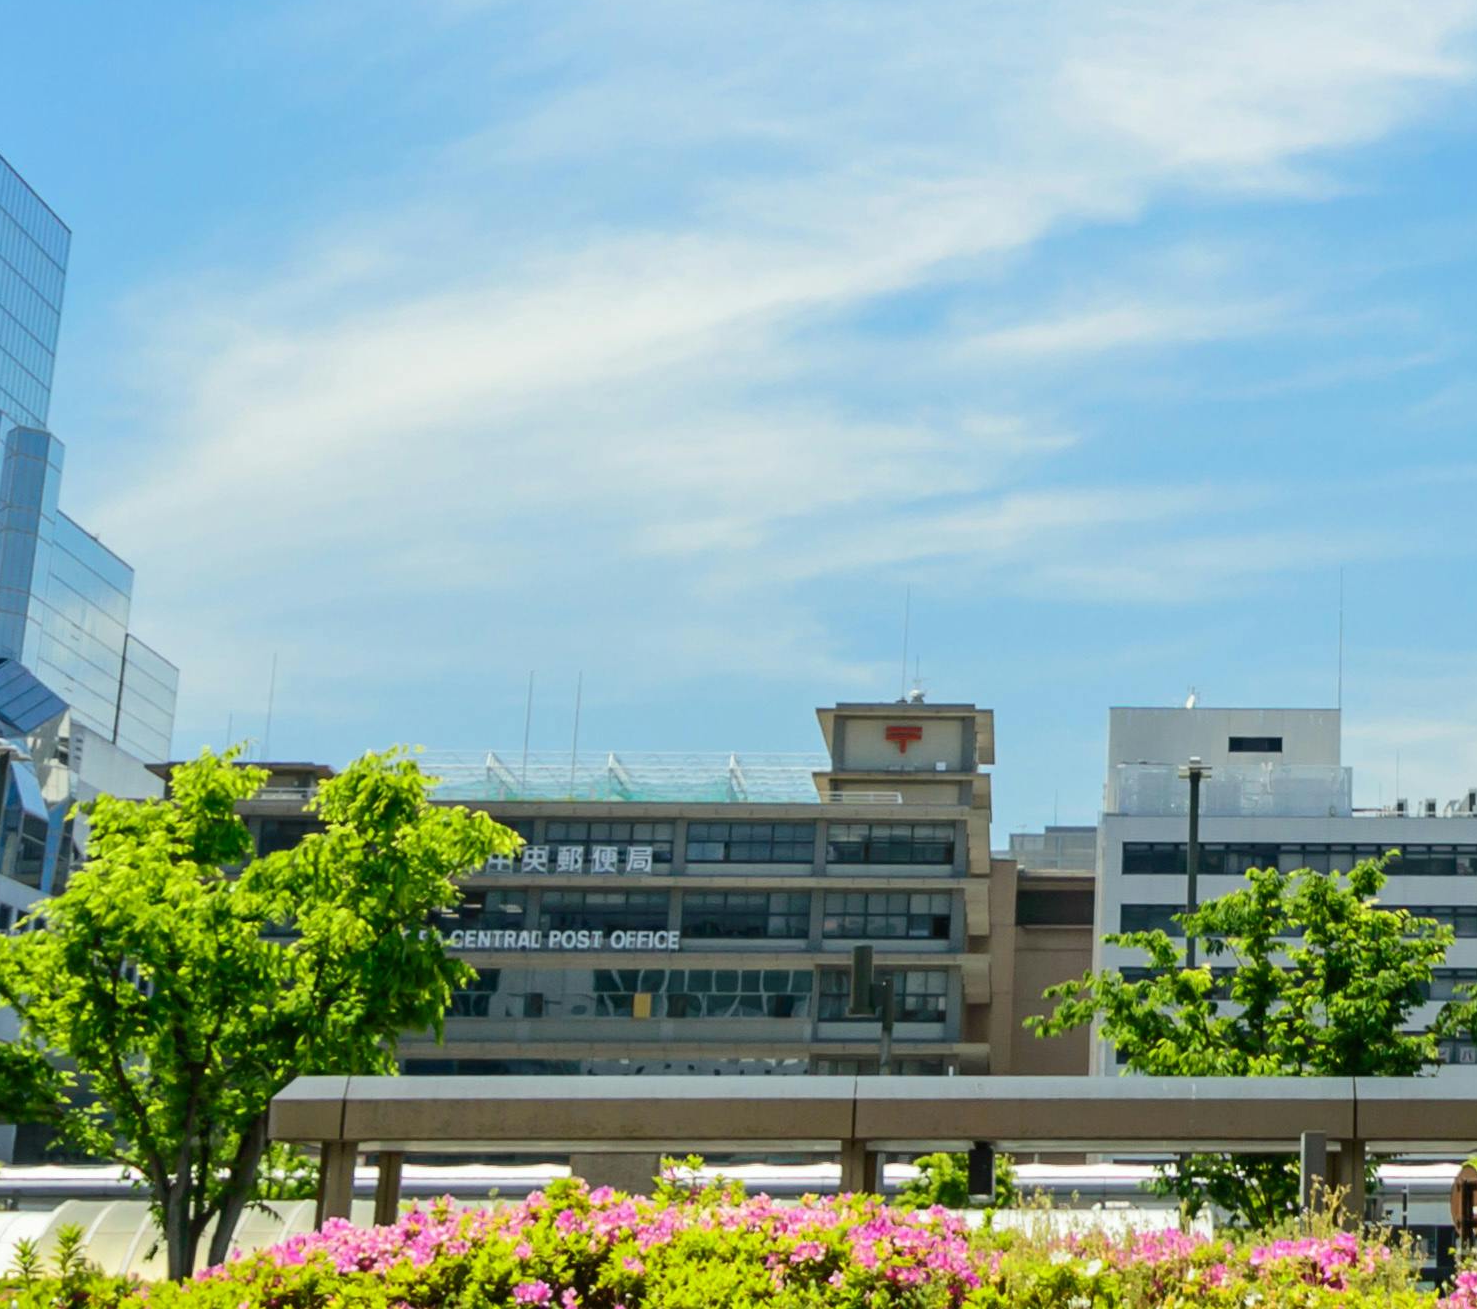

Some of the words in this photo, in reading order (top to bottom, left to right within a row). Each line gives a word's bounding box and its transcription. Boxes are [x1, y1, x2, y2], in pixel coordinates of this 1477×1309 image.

[449, 930, 541, 950] CENTRAL
[548, 930, 603, 949] POST
[610, 930, 680, 950] OFFICE
